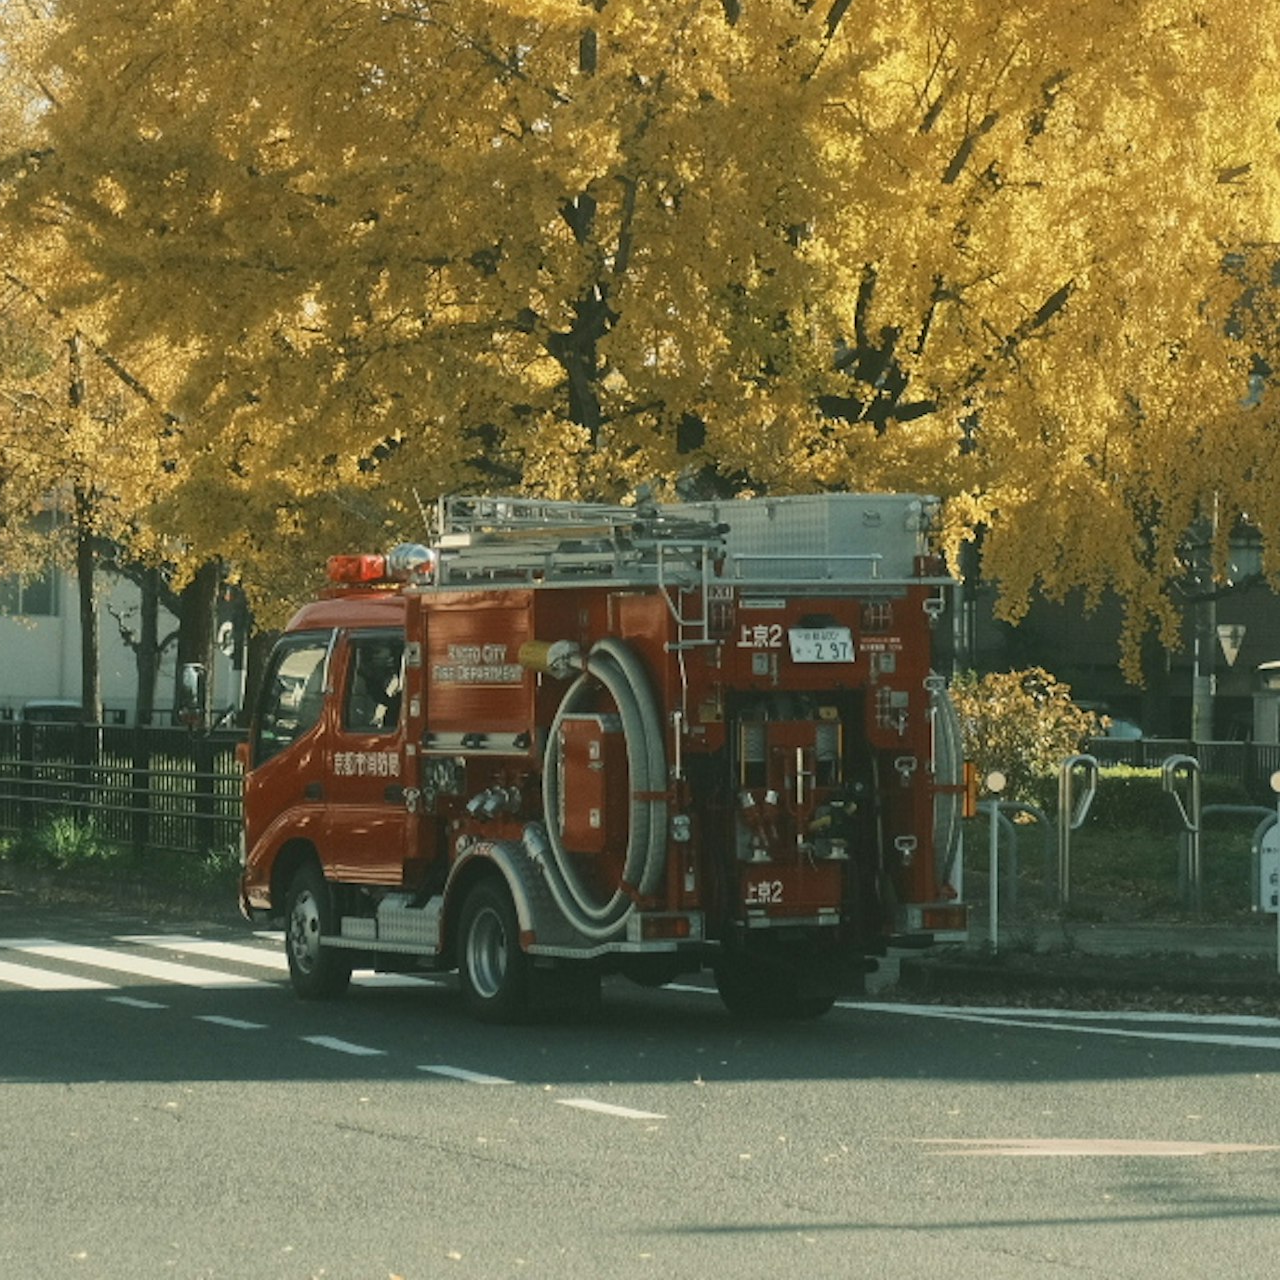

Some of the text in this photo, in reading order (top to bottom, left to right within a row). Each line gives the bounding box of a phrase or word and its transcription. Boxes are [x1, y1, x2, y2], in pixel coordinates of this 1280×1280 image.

[737, 624, 783, 648] 上京2
[334, 751, 401, 777] 京都市消防局
[744, 880, 784, 905] 上京2
